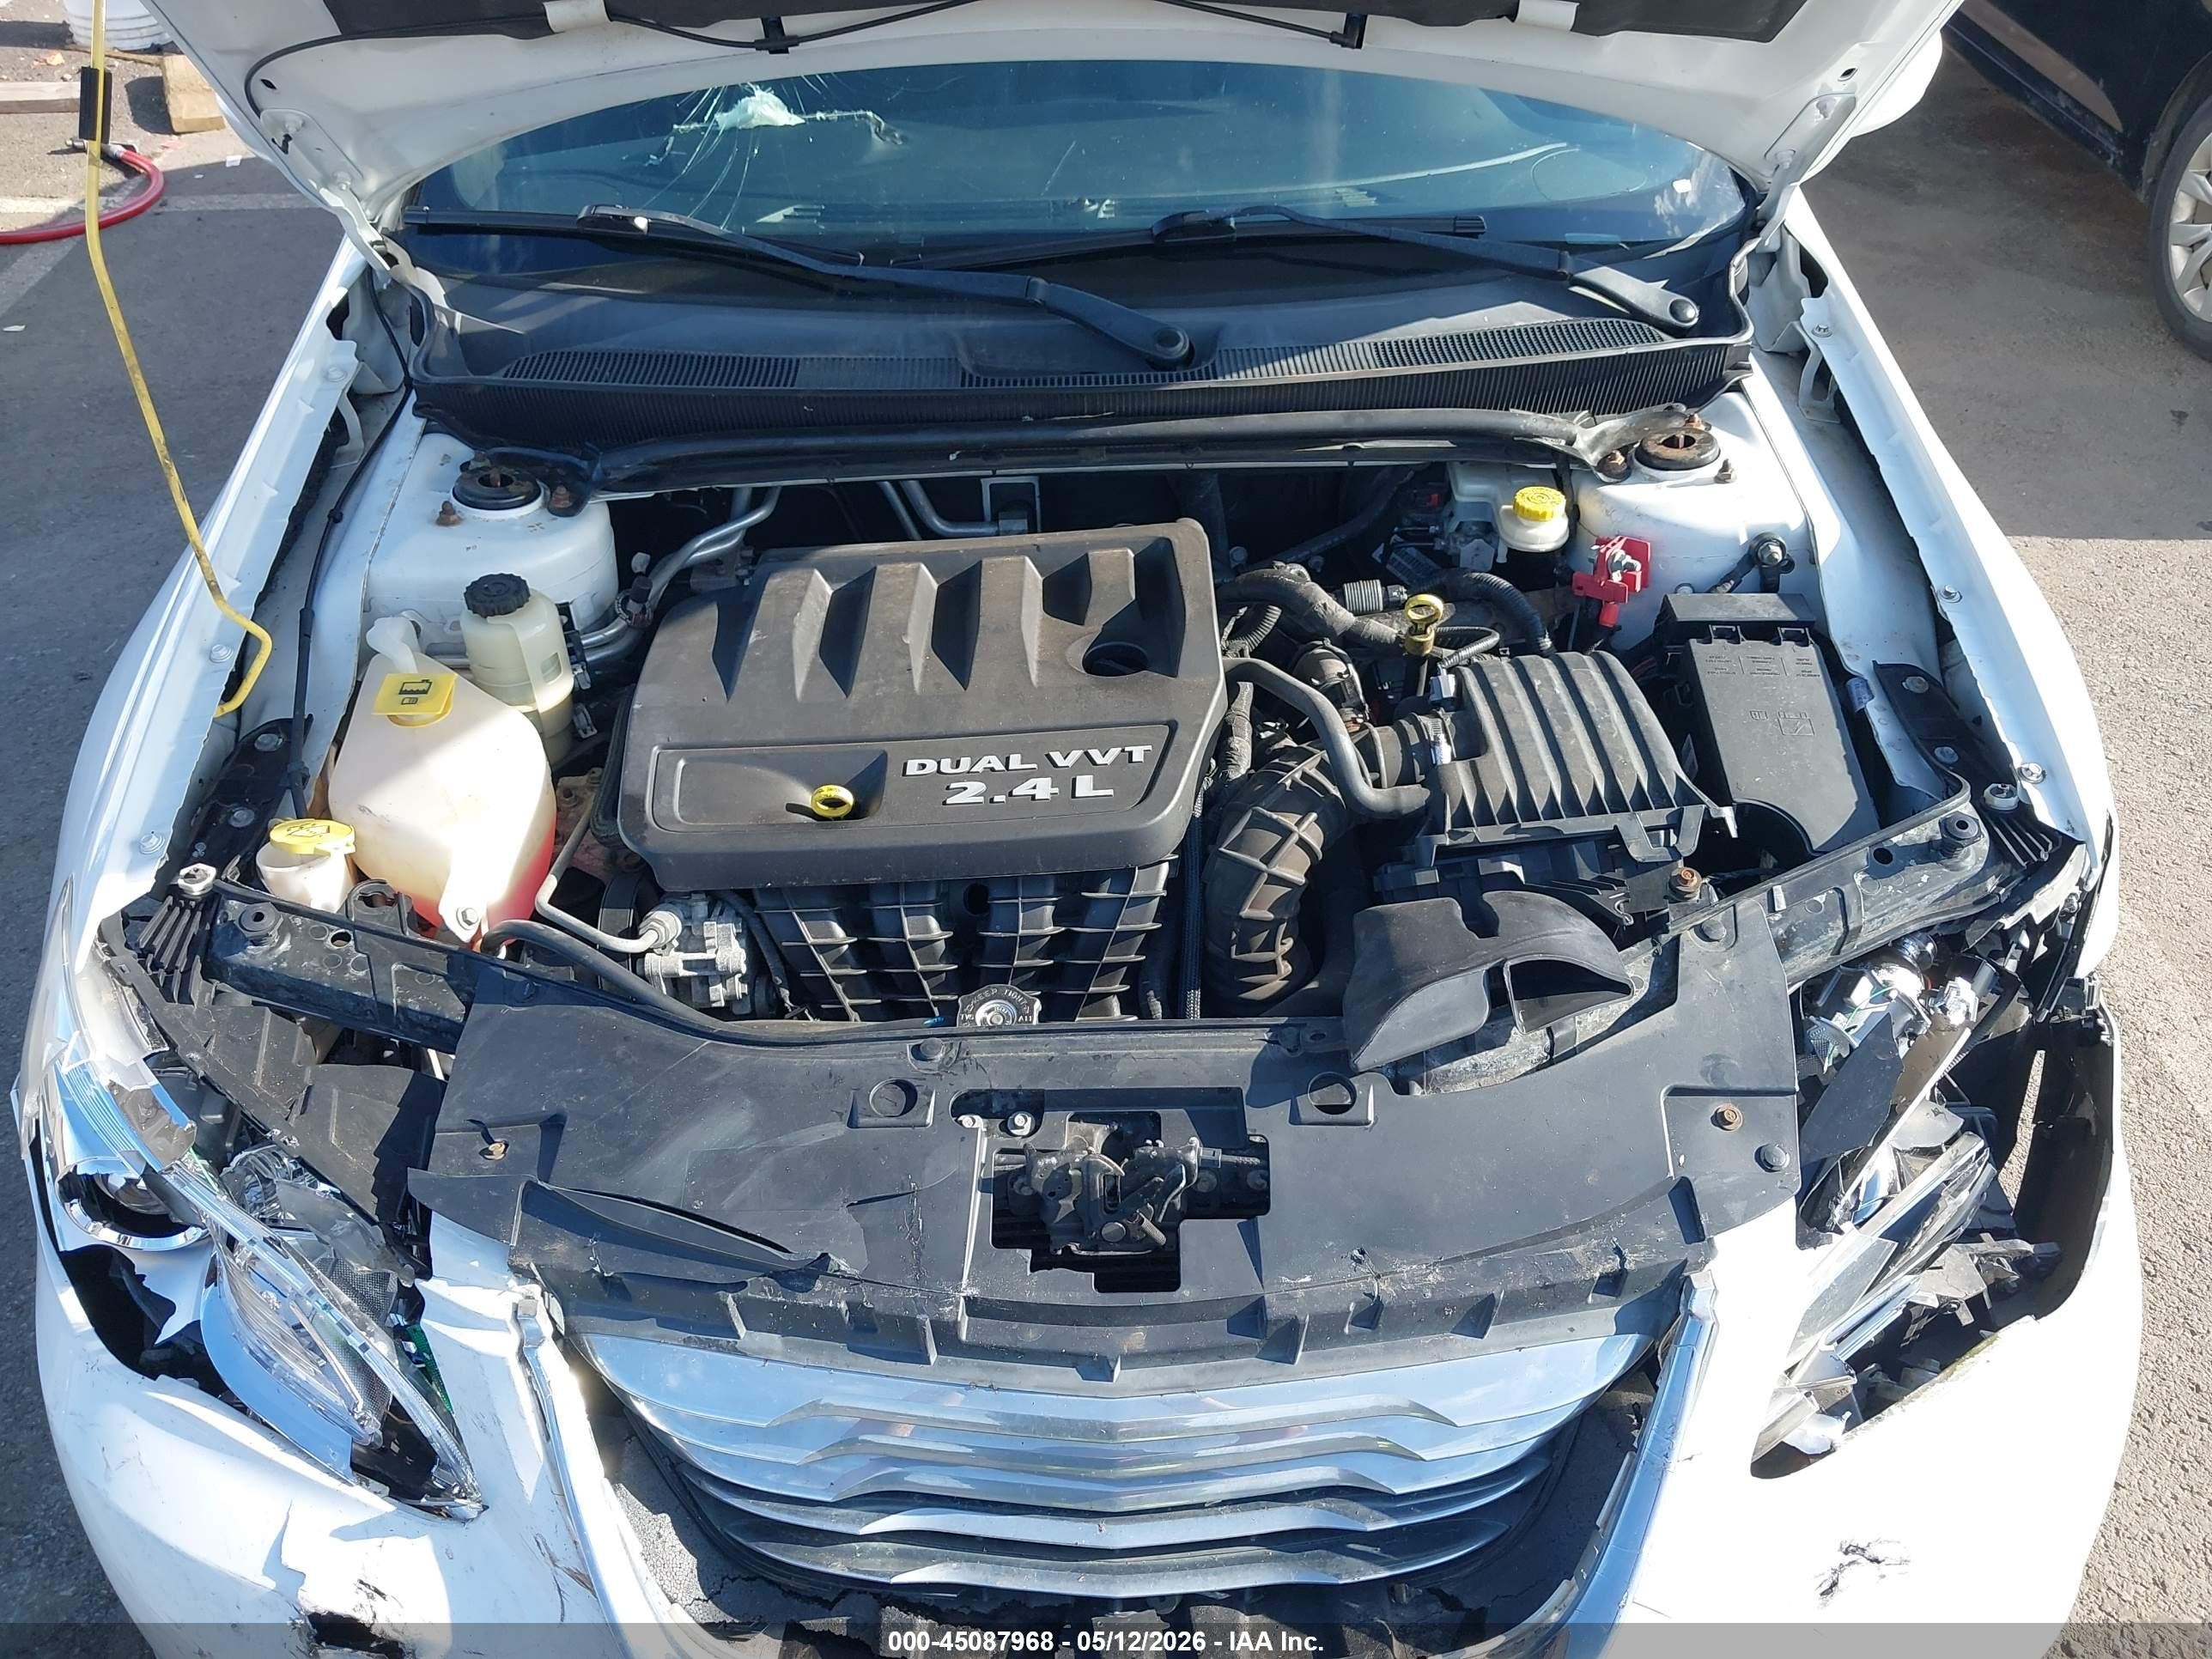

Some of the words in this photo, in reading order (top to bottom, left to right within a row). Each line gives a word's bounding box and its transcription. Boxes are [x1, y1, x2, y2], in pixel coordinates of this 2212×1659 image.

[903, 754, 1037, 775] DUAL
[1046, 745, 1152, 769] VVT
[943, 777, 1059, 805] 2.4
[1072, 775, 1114, 799] L
[973, 988, 998, 1004] KEEP
